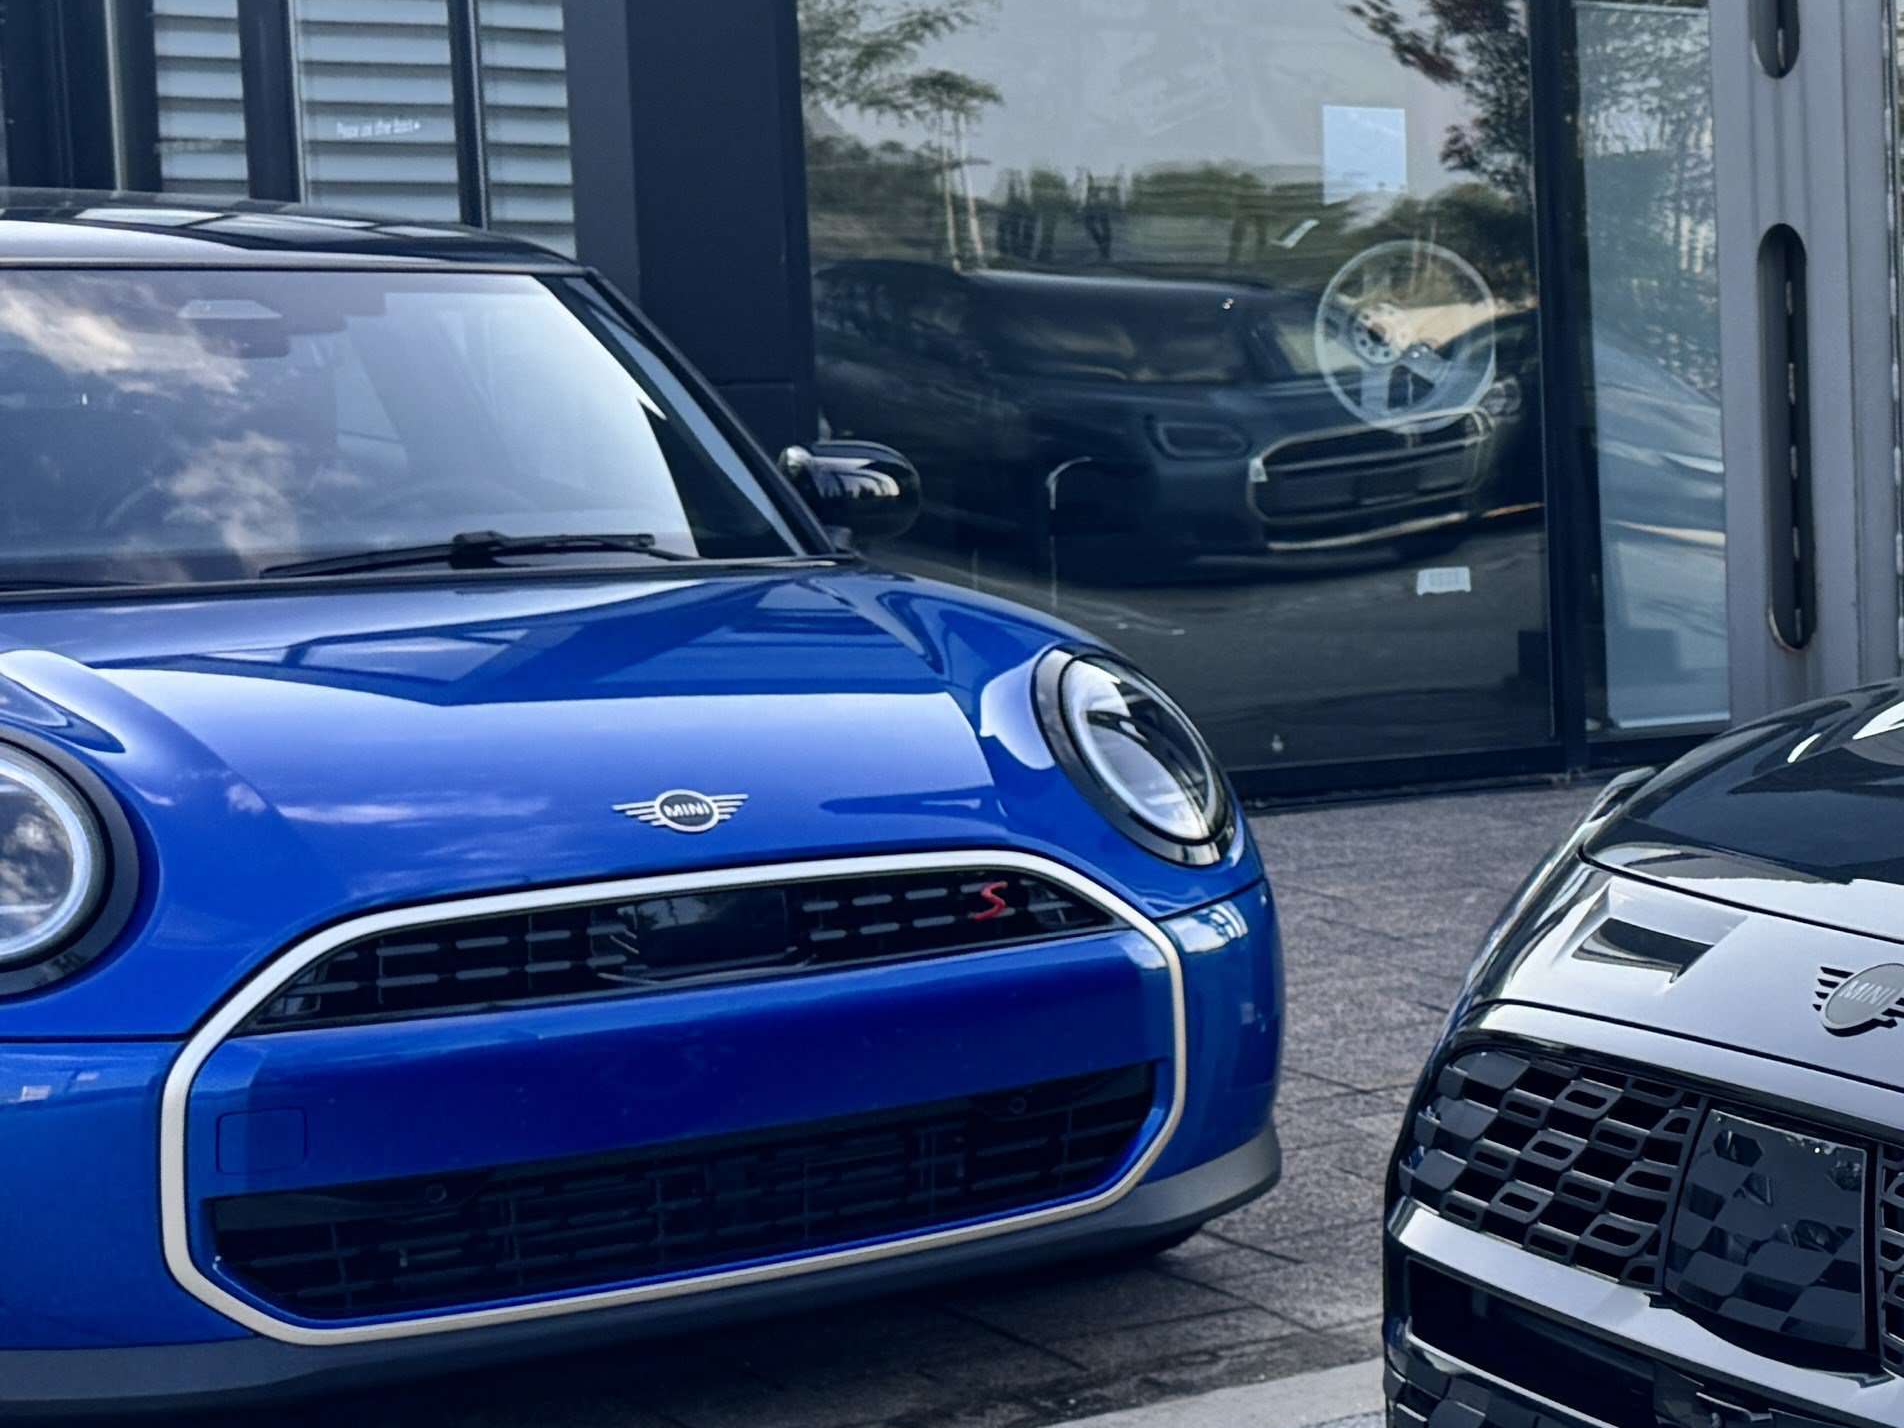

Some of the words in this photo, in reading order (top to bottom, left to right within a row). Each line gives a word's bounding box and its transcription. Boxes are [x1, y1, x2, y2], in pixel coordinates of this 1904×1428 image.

[662, 802, 710, 818] MINI
[975, 881, 1009, 922] S
[1839, 979, 1896, 1006] MINI
